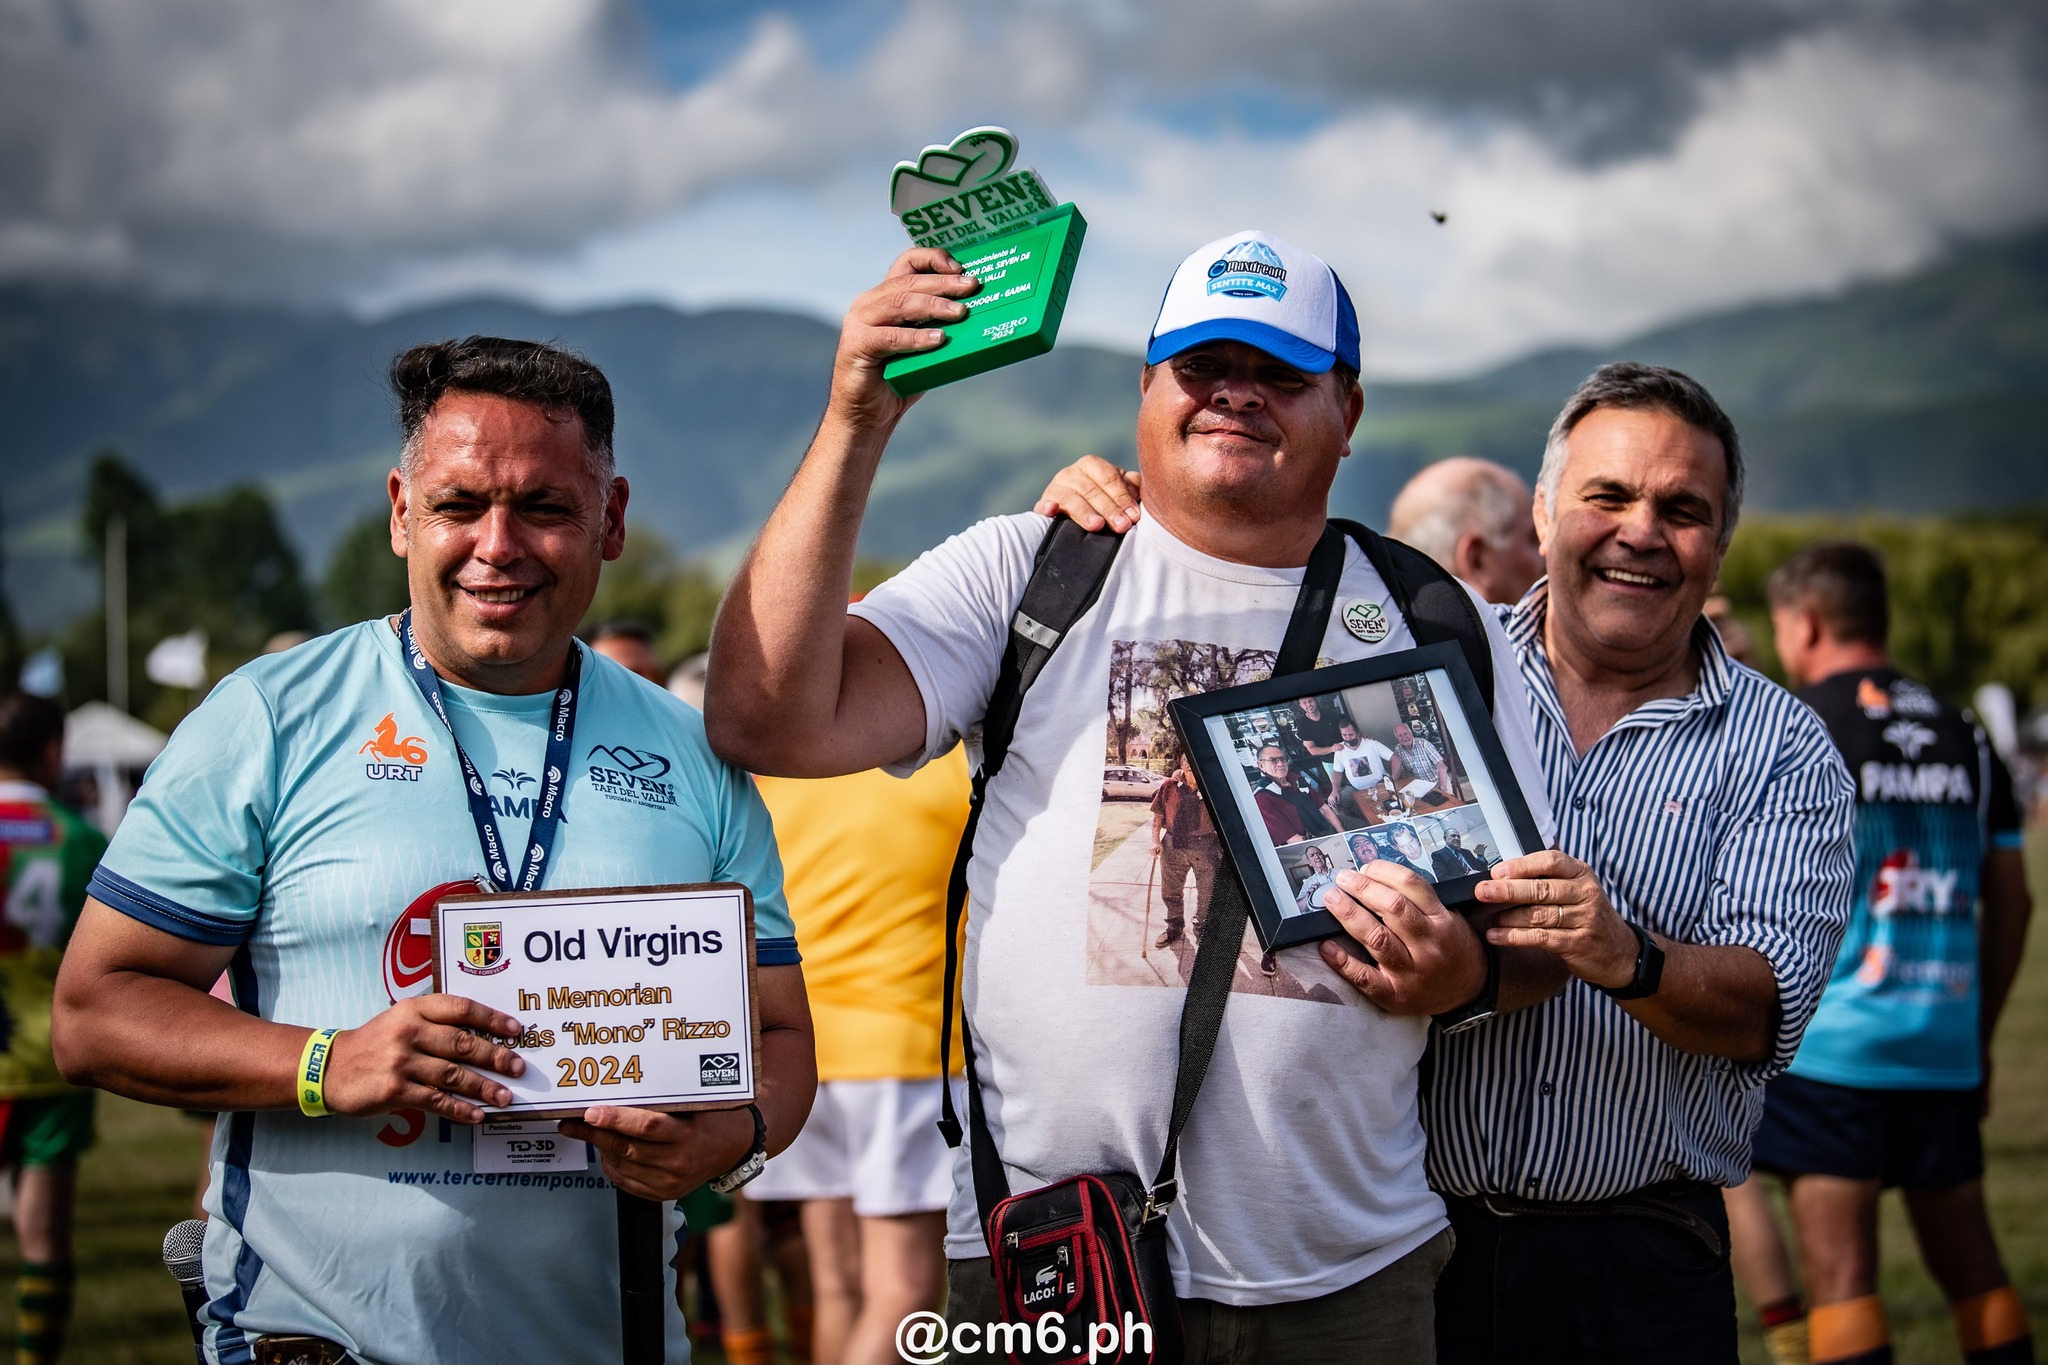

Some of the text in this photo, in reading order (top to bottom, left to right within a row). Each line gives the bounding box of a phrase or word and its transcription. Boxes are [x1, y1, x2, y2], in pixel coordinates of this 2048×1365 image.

[902, 174, 1029, 238] SEVEN
[915, 201, 1038, 248] TAFI DEL VALLE
[981, 264, 994, 274] DEL
[995, 255, 1020, 270] SEVEN
[1020, 252, 1031, 262] DE
[984, 269, 1007, 283] VALLE
[1211, 279, 1279, 294] SENTITE MAX
[1004, 282, 1031, 297] GARMA
[982, 316, 1028, 336] ENERO
[991, 327, 1014, 341] 2024
[1350, 619, 1383, 629] SEVEN
[555, 707, 570, 742] Macro
[366, 763, 423, 782] URT
[589, 766, 667, 797] SEVEN
[1860, 760, 1974, 804] PAMPA
[542, 784, 559, 819] Macro
[592, 783, 618, 794] TAFI
[619, 788, 640, 799] DEL
[641, 792, 674, 805] VALLE
[483, 824, 500, 860] Macro
[523, 863, 540, 892] Macr
[524, 925, 723, 967] Old Virgins
[518, 983, 672, 1011] In Memorian
[662, 1018, 731, 1041] Rizzo
[557, 1054, 643, 1087] 2024
[701, 1068, 735, 1078] SEVEN
[506, 1140, 555, 1152] TD-3D
[1024, 1282, 1076, 1305] LACOSE
